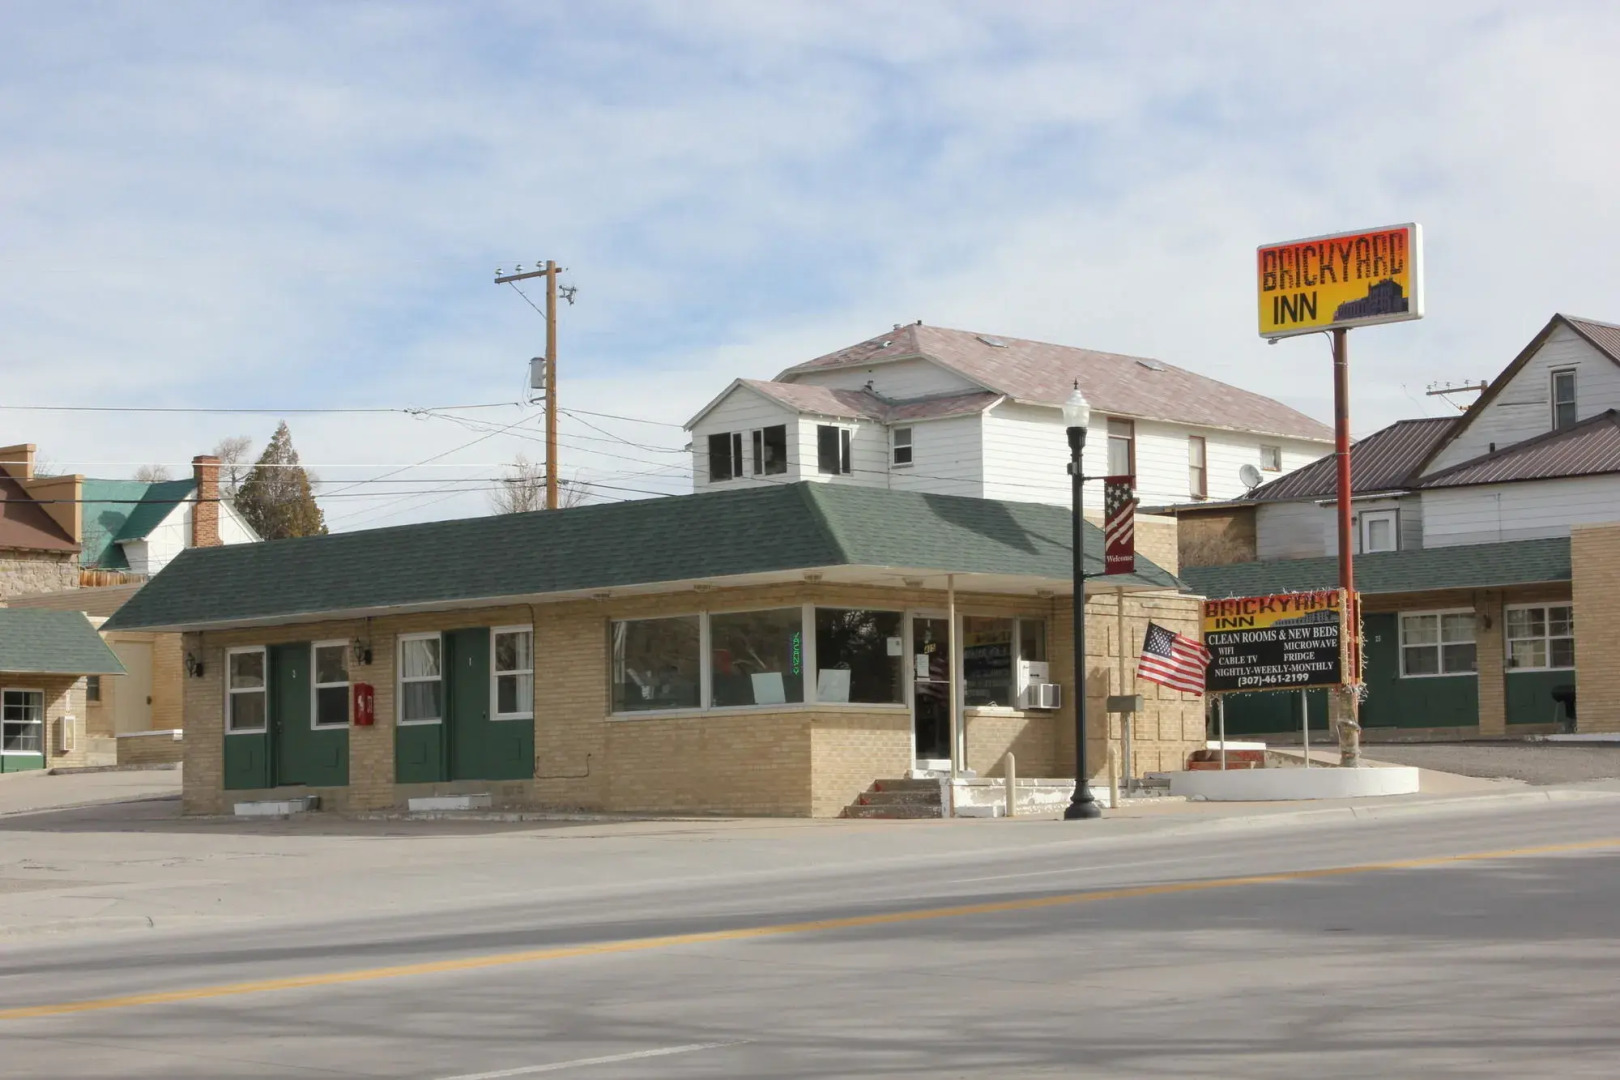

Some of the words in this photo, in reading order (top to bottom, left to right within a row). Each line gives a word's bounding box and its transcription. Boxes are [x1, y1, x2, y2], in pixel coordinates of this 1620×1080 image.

[1262, 232, 1403, 292] BRICKYARD
[1273, 291, 1317, 325] INN
[1205, 591, 1339, 617] BRICKYARD
[1216, 616, 1254, 629] INN
[1208, 633, 1240, 645] CLEAN
[1242, 630, 1277, 643] ROOMS
[1279, 629, 1286, 640] &
[1288, 628, 1311, 640] NEW
[1313, 626, 1338, 638] BEDS
[1218, 646, 1234, 655] WIFI
[1284, 639, 1338, 650] MICROWAVE
[1218, 656, 1246, 665] CABLE
[1247, 655, 1258, 664] TV
[1284, 651, 1315, 662] FRIDGE
[1215, 661, 1334, 677] NIGHTLY-WEEKLY-MONTHLY
[1238, 673, 1309, 688] (307)-461-2199
